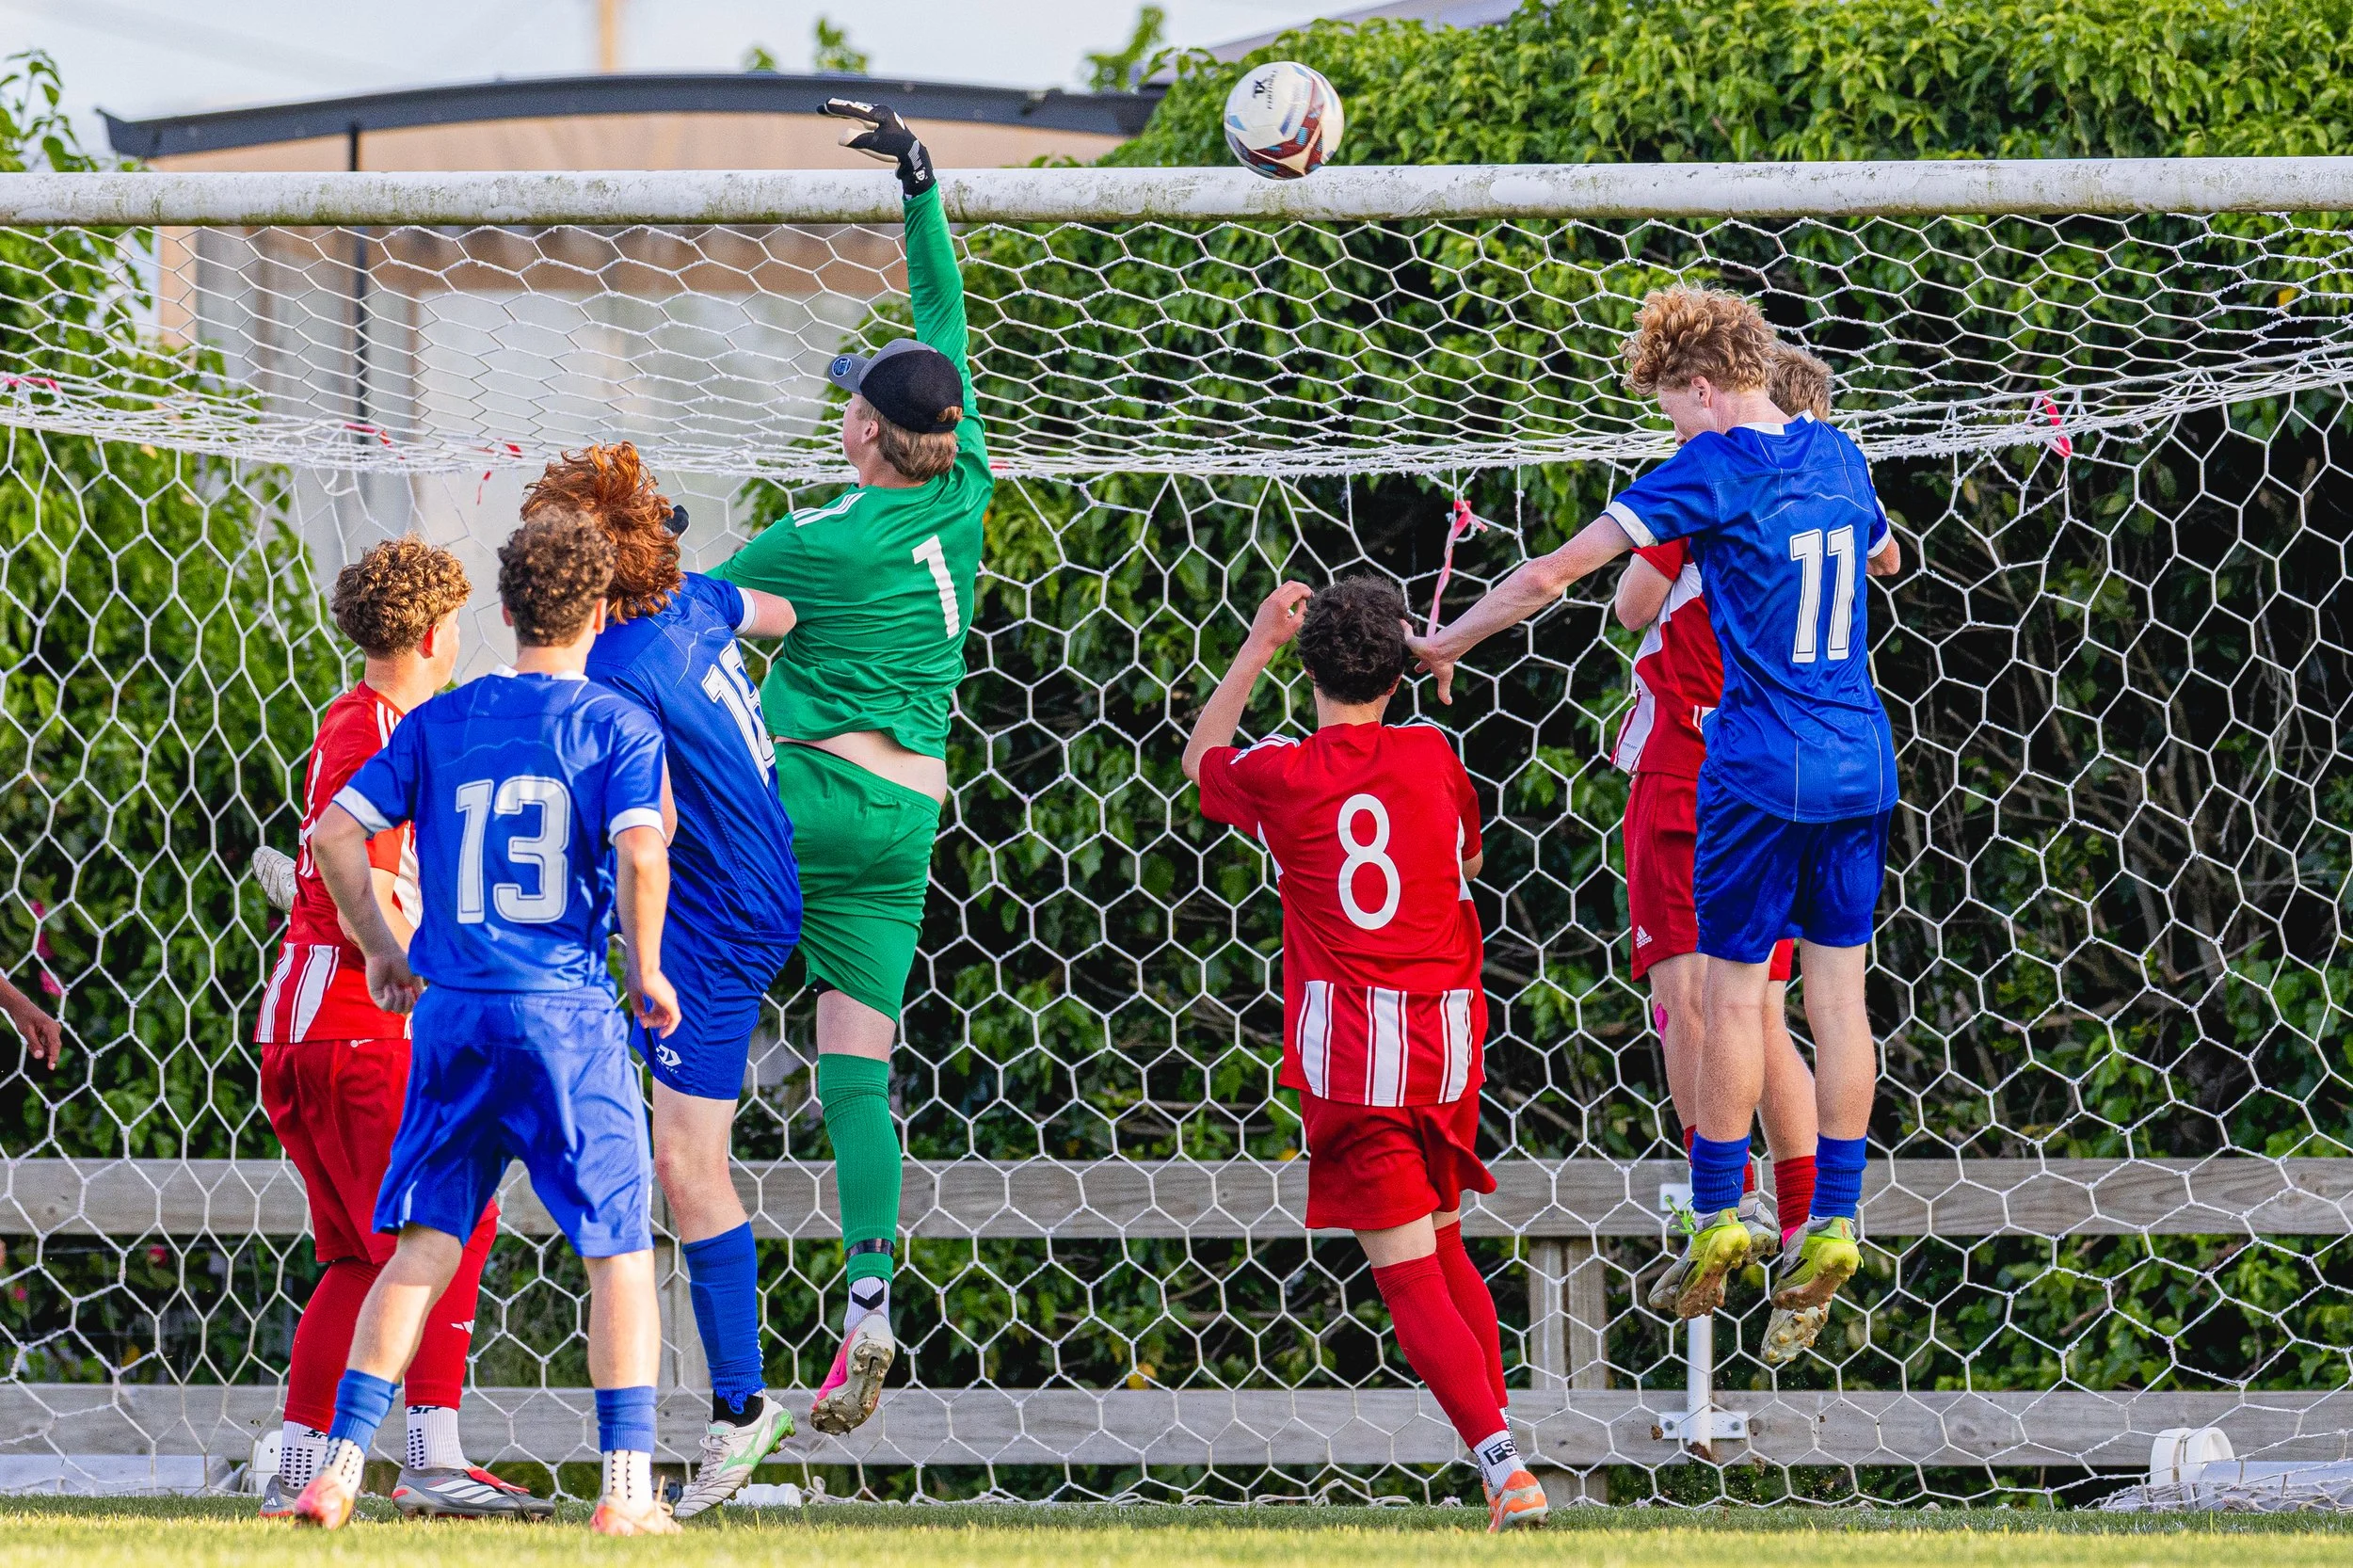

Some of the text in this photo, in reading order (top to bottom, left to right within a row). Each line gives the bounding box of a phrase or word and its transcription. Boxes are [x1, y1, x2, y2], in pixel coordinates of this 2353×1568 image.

[912, 534, 960, 640] 1
[1789, 524, 1855, 664] 11
[456, 775, 571, 925] 13
[1337, 793, 1401, 930] 8
[1486, 1440, 1516, 1464] FS
